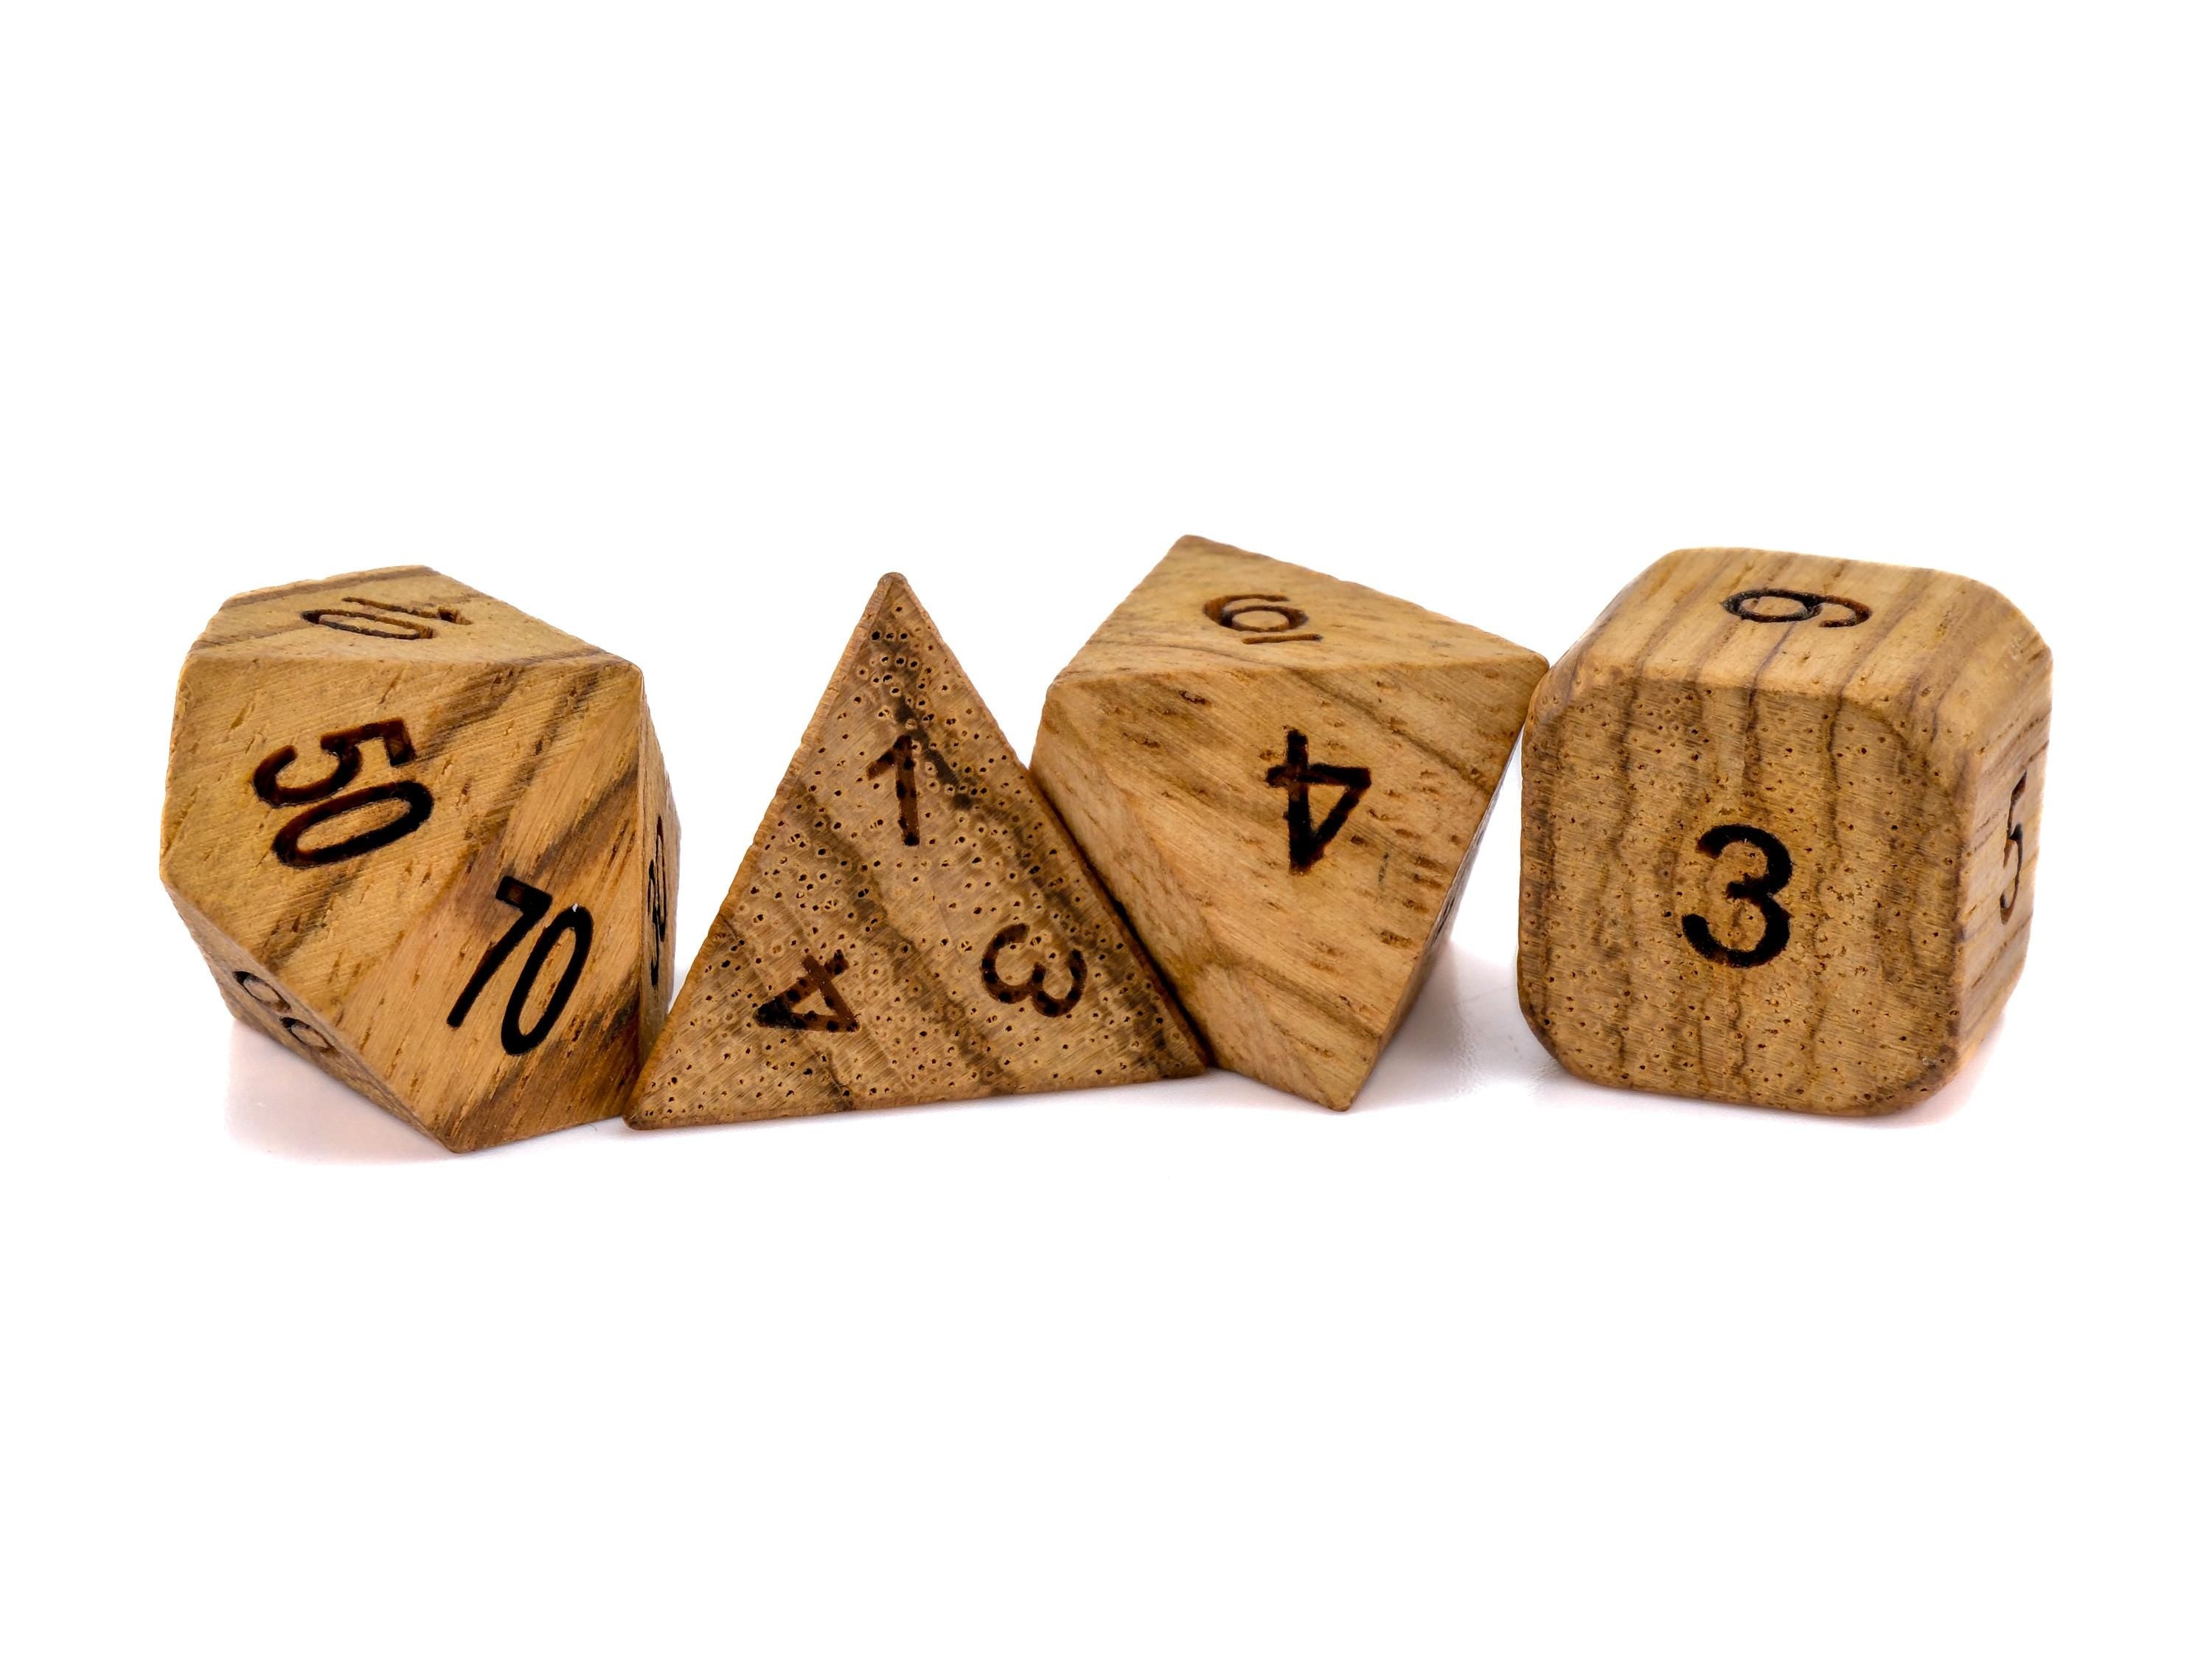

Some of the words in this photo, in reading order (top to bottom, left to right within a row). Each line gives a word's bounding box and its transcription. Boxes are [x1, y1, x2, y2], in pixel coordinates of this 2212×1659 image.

[301, 597, 473, 640] 10
[1722, 588, 1873, 628] 6
[253, 717, 434, 867] 50
[866, 734, 920, 846] 1
[1265, 726, 1371, 876] 4
[1999, 772, 2027, 925] 5
[1681, 823, 1793, 969] 3
[446, 876, 595, 1056] 70
[753, 950, 860, 1032] 4
[981, 922, 1087, 1018] 3
